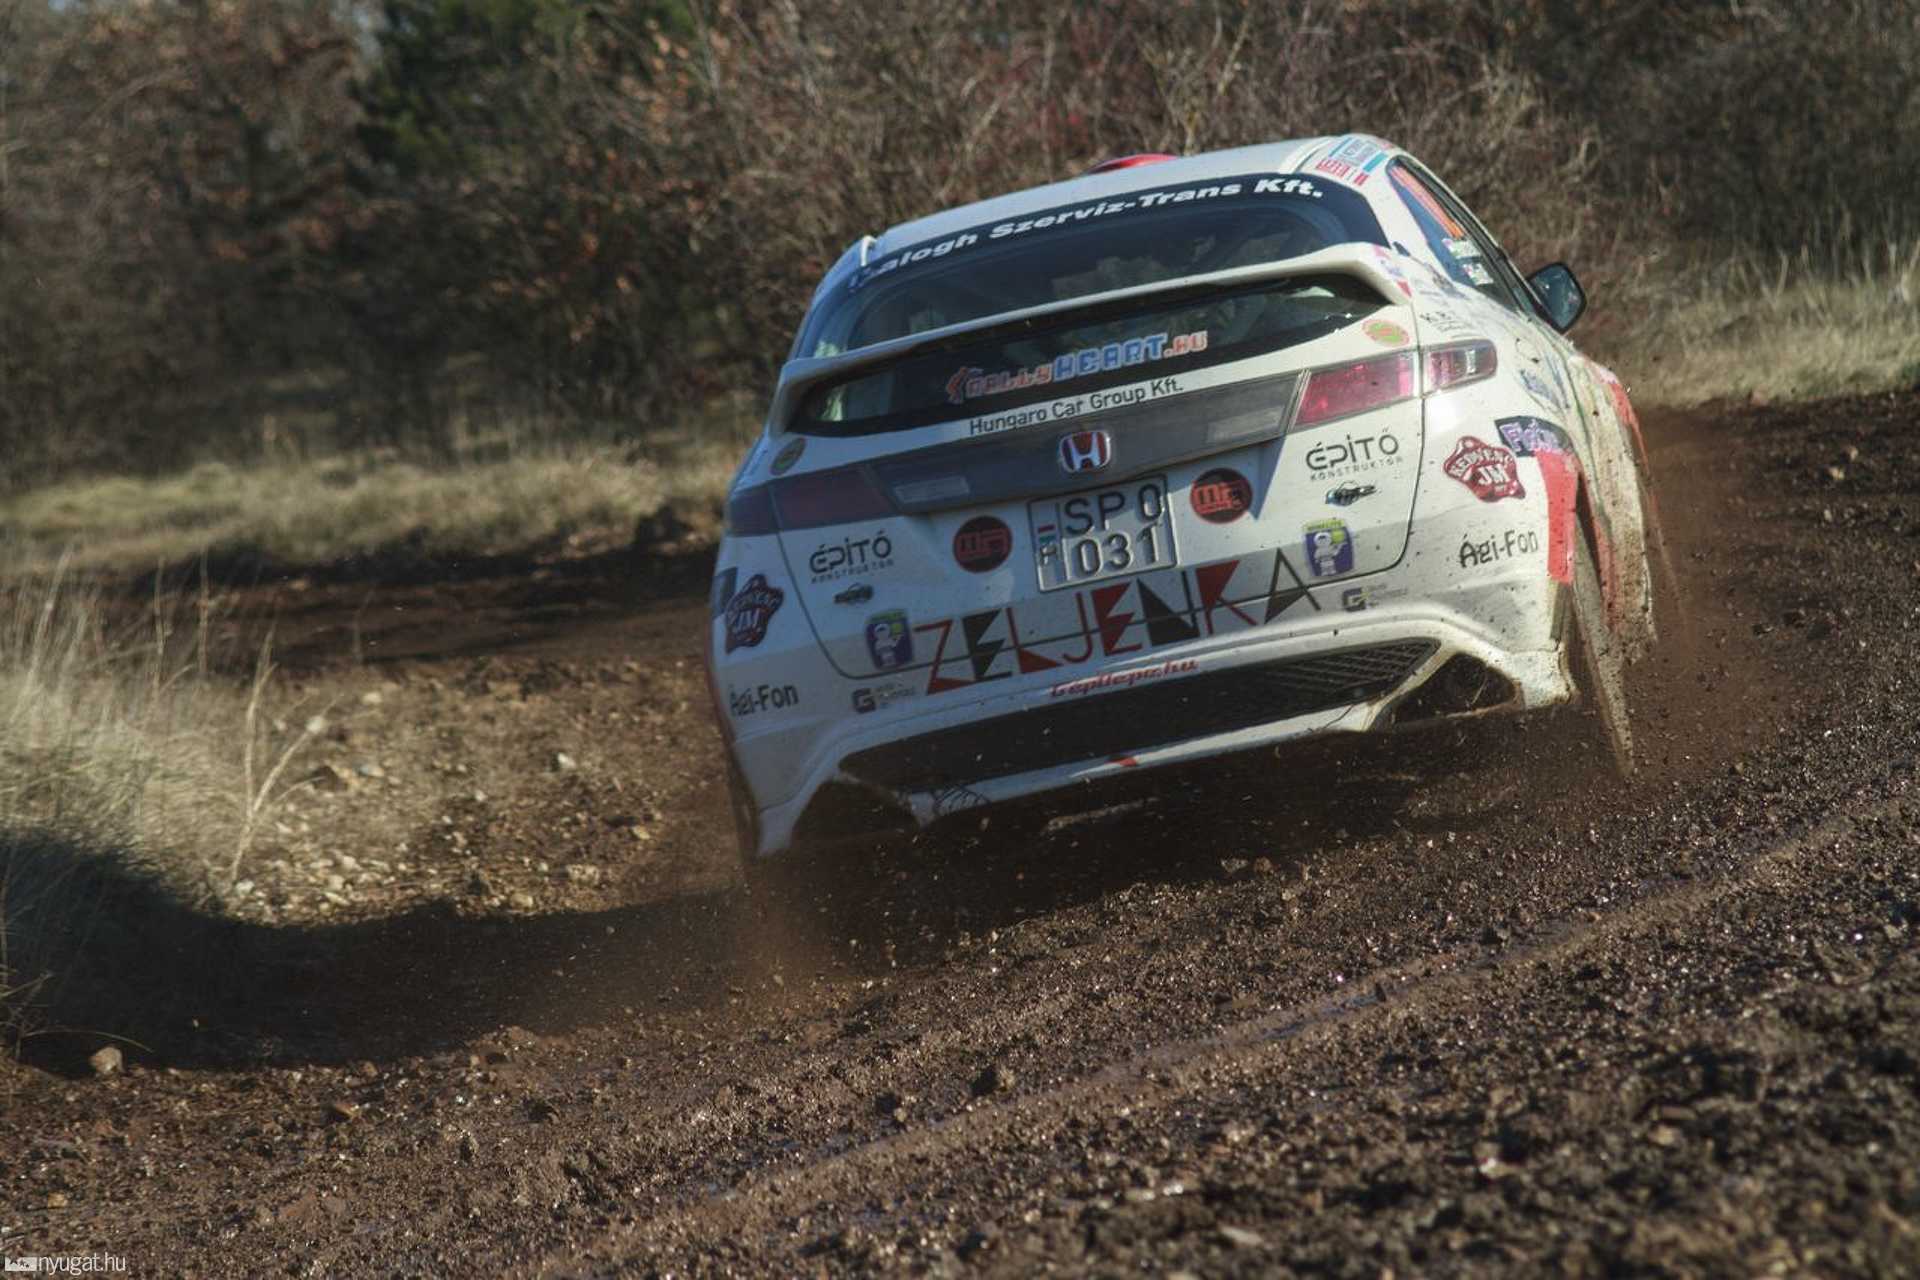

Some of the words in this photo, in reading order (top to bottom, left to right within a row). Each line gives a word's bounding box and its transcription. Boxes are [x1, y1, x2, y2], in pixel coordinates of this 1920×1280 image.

[989, 183, 1243, 239] Szerviz-Trans
[1253, 178, 1324, 199] Kft.
[969, 407, 1048, 436] Hungaro
[1052, 398, 1085, 419] Car
[1090, 385, 1146, 410] Group
[1150, 377, 1184, 398] Kft.
[1064, 491, 1126, 535] SP
[1077, 521, 1160, 576] 031
[913, 547, 1322, 696] ZELJENKA
